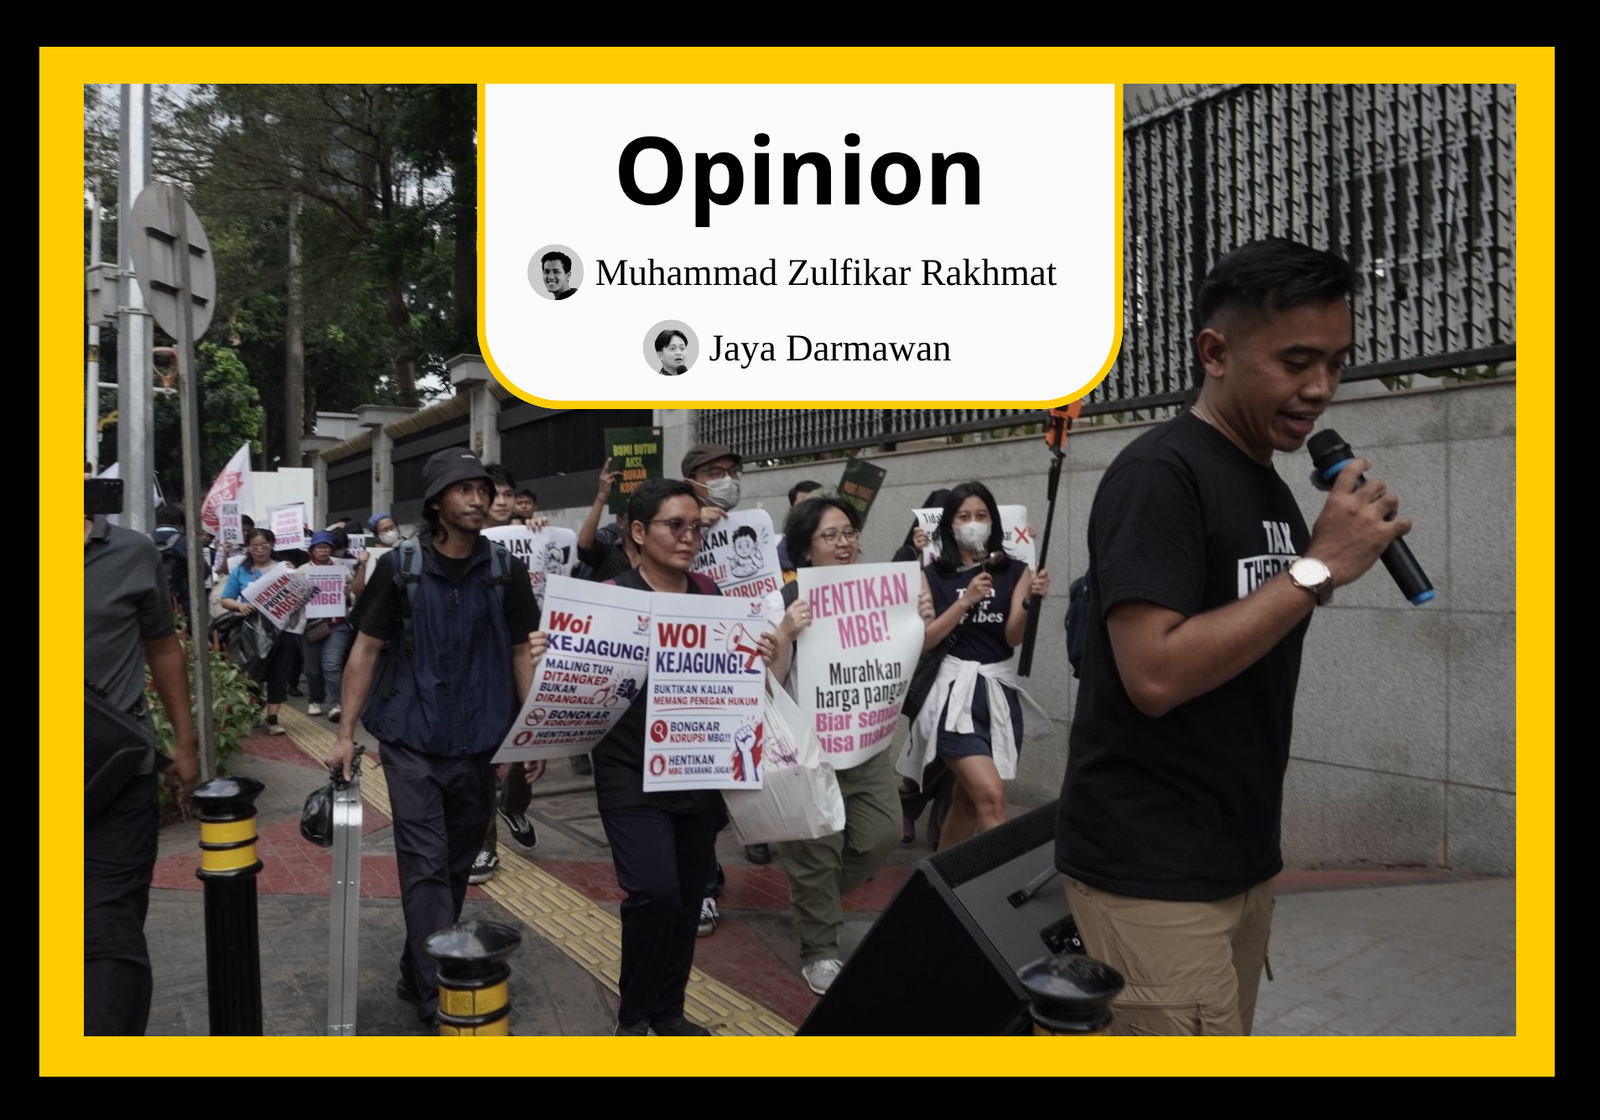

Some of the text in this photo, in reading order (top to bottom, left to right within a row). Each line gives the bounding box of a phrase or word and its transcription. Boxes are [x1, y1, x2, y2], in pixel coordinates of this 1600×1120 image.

[613, 443, 657, 456] BUMI BUTUH
[623, 468, 647, 481] BUKAN
[1262, 520, 1297, 554] TAX
[263, 587, 290, 612] PROYEK
[809, 573, 909, 619] HENTIKAN
[549, 610, 593, 635] Woi
[837, 610, 891, 650] MBG!
[658, 623, 706, 648] WOI
[546, 633, 650, 661] KEJAGUNG!
[545, 658, 614, 675] MALING TUH
[656, 651, 743, 674] KEJAGUNG!
[543, 671, 609, 686] DITANGKEP
[829, 659, 902, 686] Murahkan
[539, 682, 578, 693] BUKAN
[654, 684, 734, 695] BUKTIKAN KALIAN
[653, 697, 758, 706] MEMANG PENEGAK HUKUM
[816, 686, 860, 712] harga
[548, 709, 610, 720] BONGKAR
[816, 712, 853, 733] Biar
[536, 730, 585, 739] HENTIKAN
[670, 721, 720, 732] BONGKAR
[669, 733, 706, 743] KORUPSI
[668, 755, 715, 765] HENTIKAN
[668, 767, 683, 775] MBG
[684, 766, 712, 775] SEKARANG
